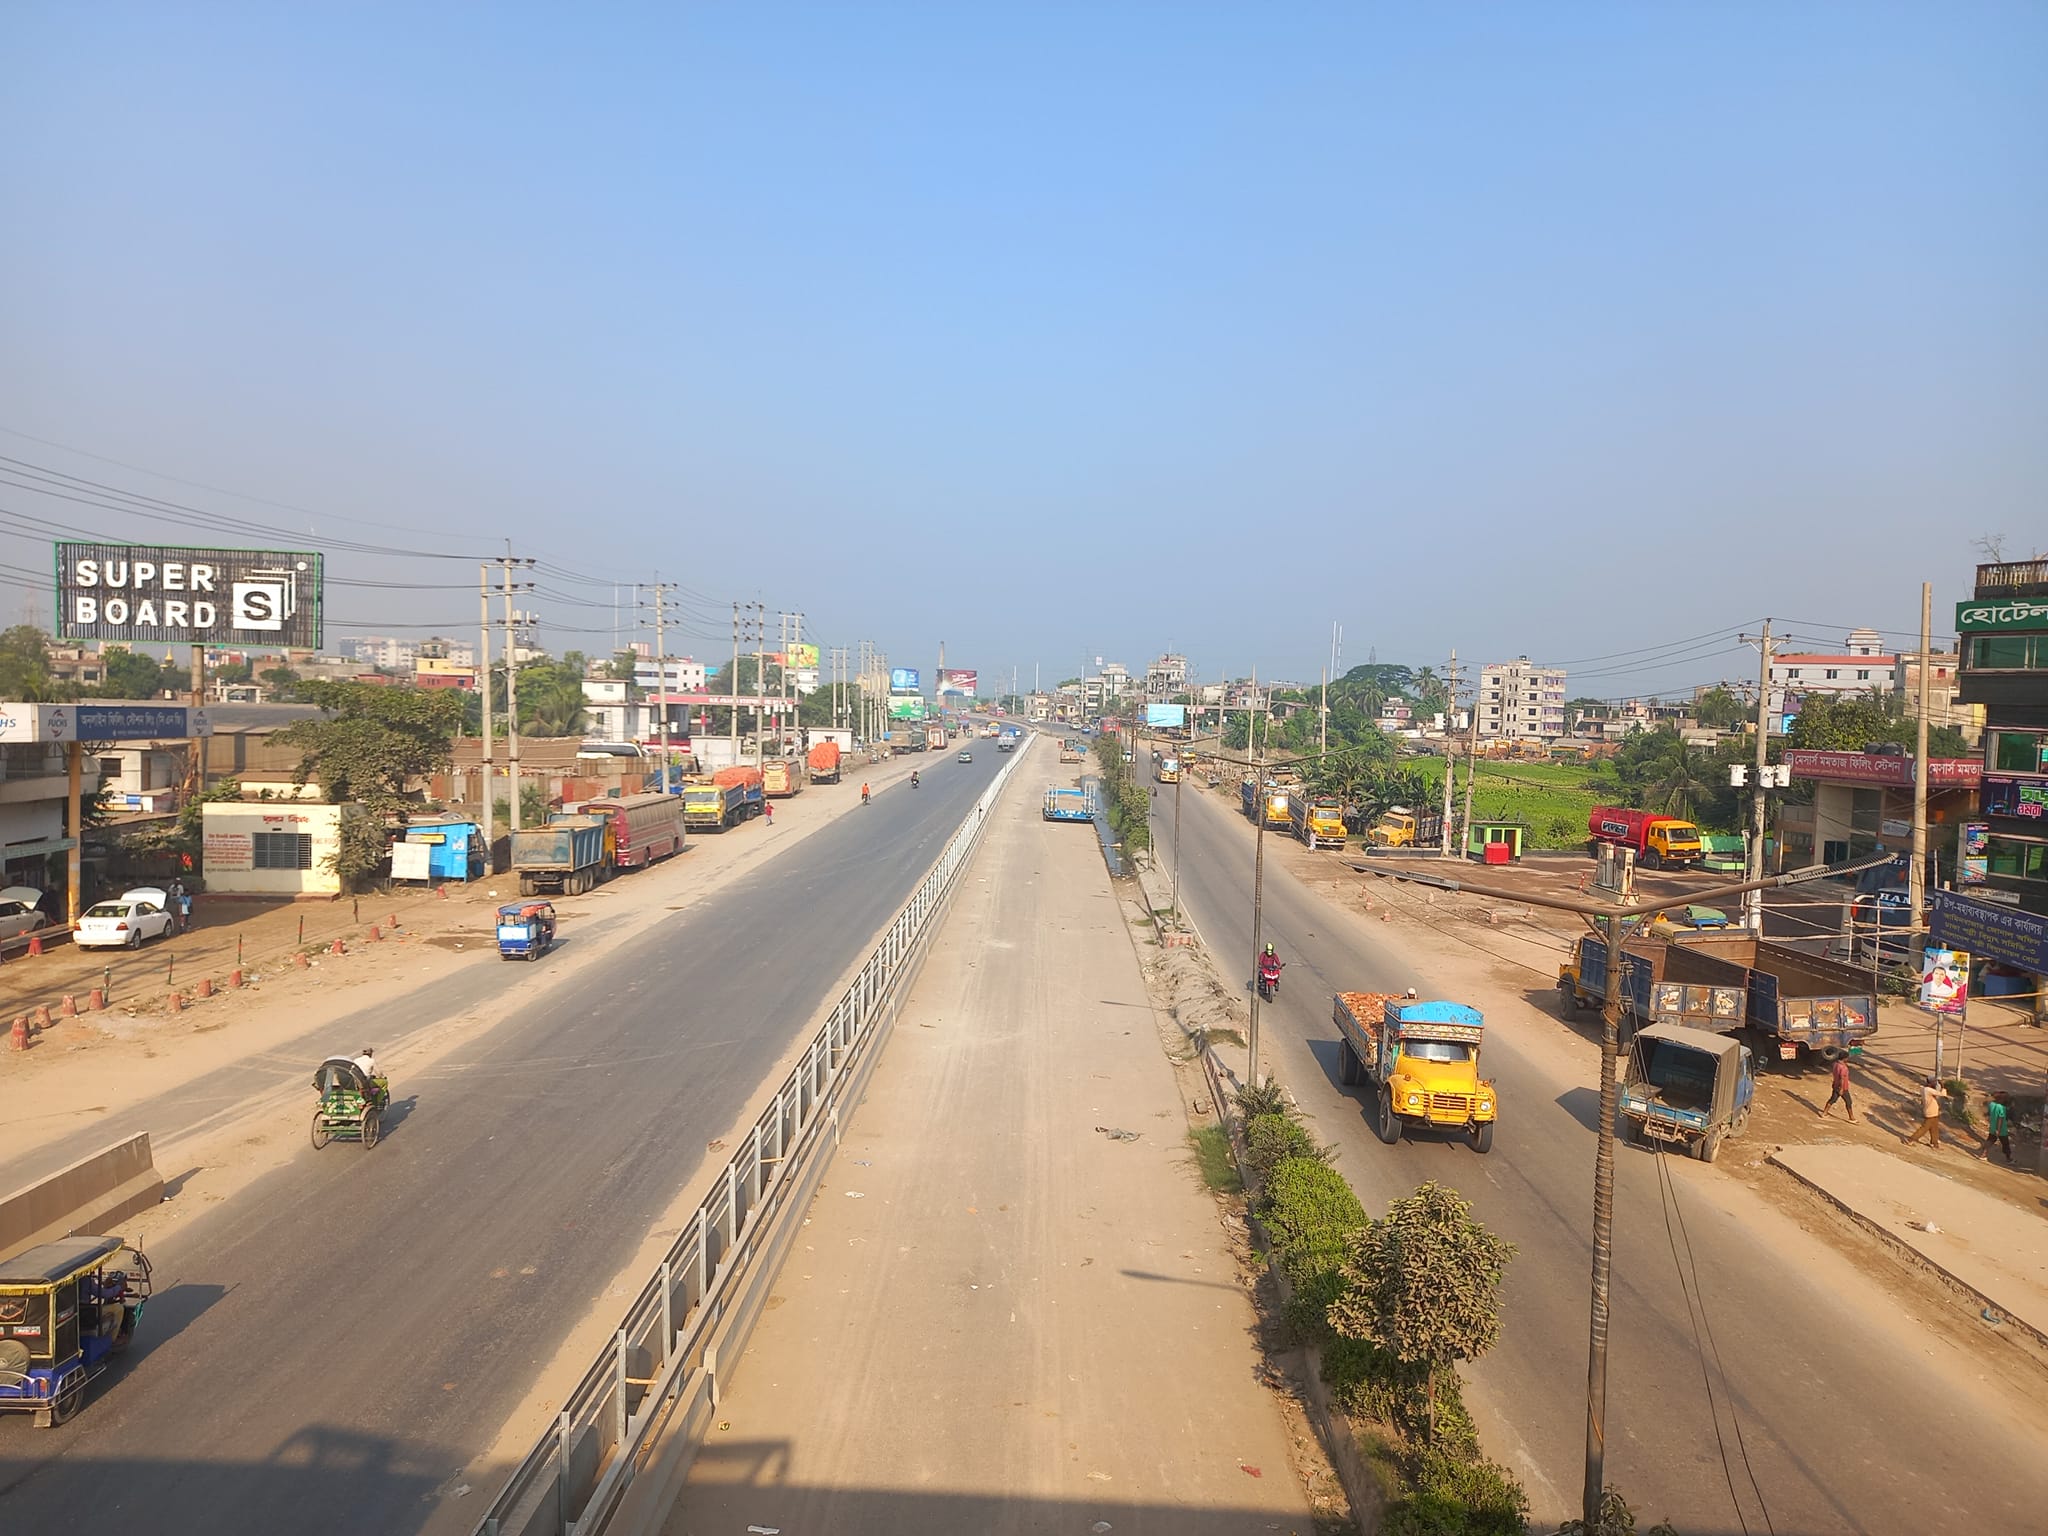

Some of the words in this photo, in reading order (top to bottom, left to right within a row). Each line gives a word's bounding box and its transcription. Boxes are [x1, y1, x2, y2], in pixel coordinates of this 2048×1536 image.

[76, 561, 215, 592] SUPER
[76, 597, 217, 628] BOARD
[1961, 601, 2048, 624] হোটেল
[1795, 754, 1817, 766] মেসার্স
[1820, 756, 1847, 769] মমতাজ
[1850, 755, 1873, 772] ফিলিং
[1874, 759, 1901, 772] স্টেশন
